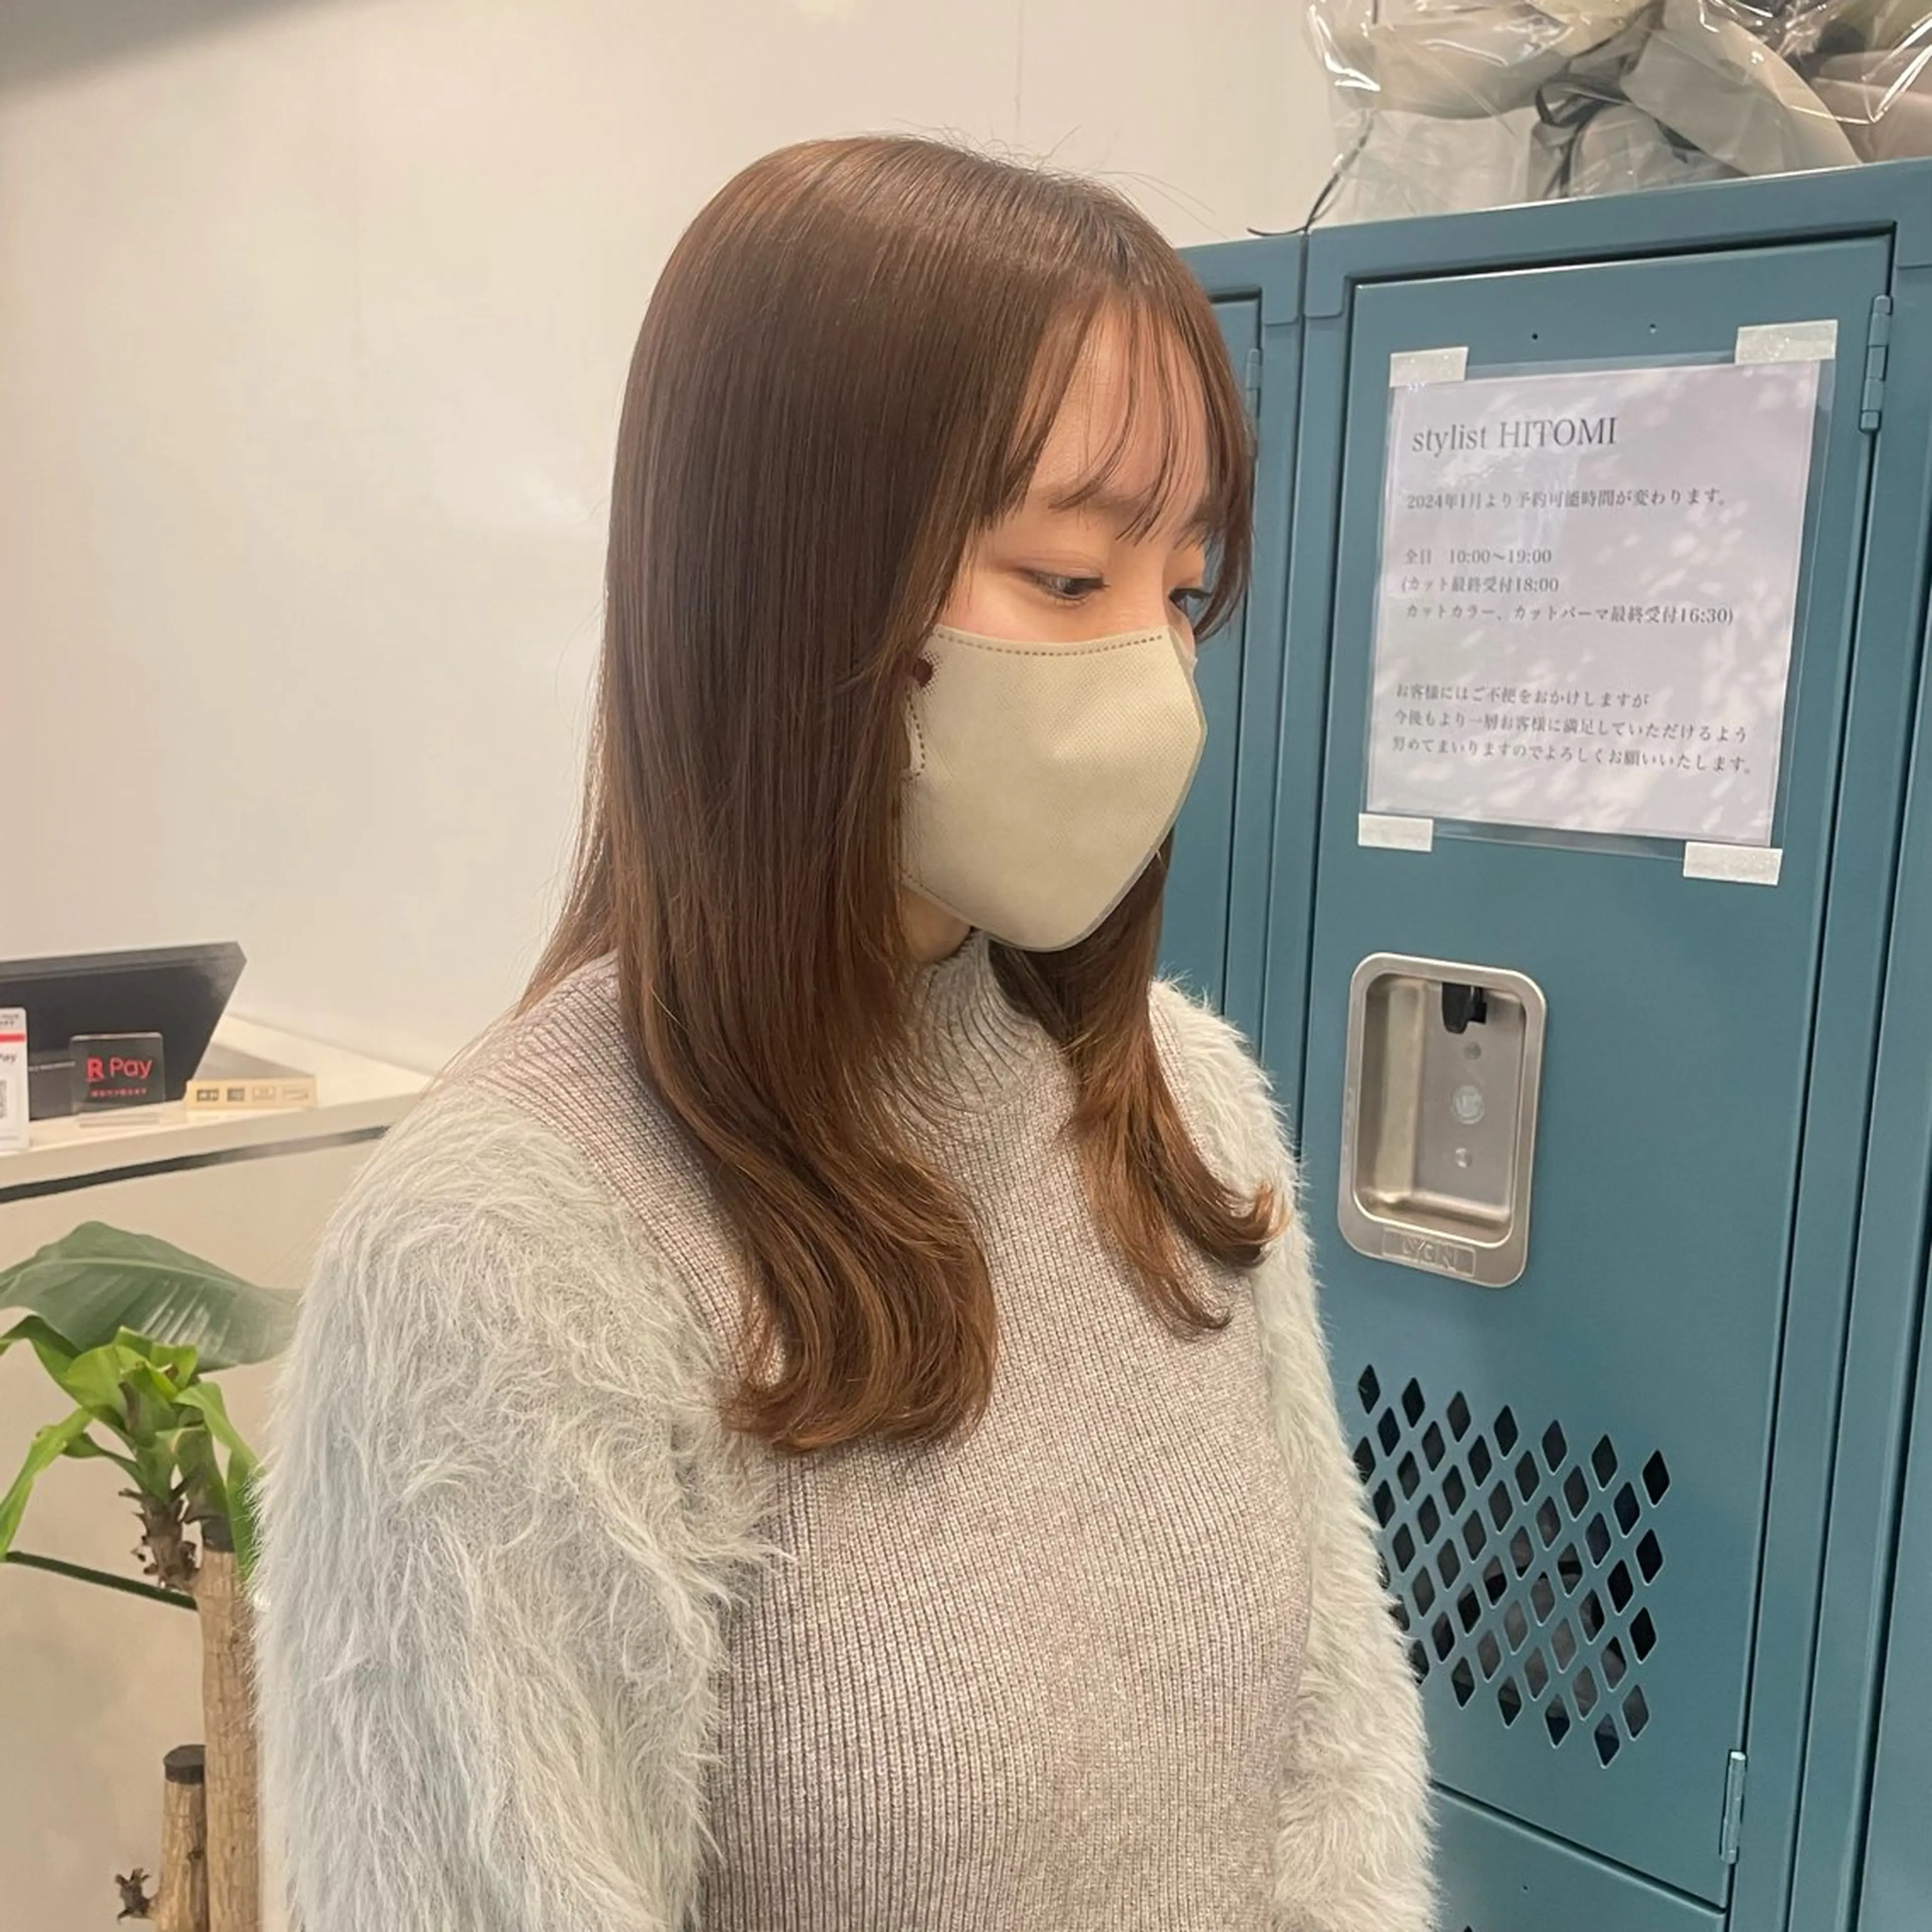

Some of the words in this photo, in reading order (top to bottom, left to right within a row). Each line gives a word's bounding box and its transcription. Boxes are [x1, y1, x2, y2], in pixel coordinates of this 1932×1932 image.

[1412, 424, 1487, 458] stylist
[1498, 417, 1619, 448] HITOMI
[1404, 548, 1432, 565] 全日
[110, 1056, 152, 1080] Pay
